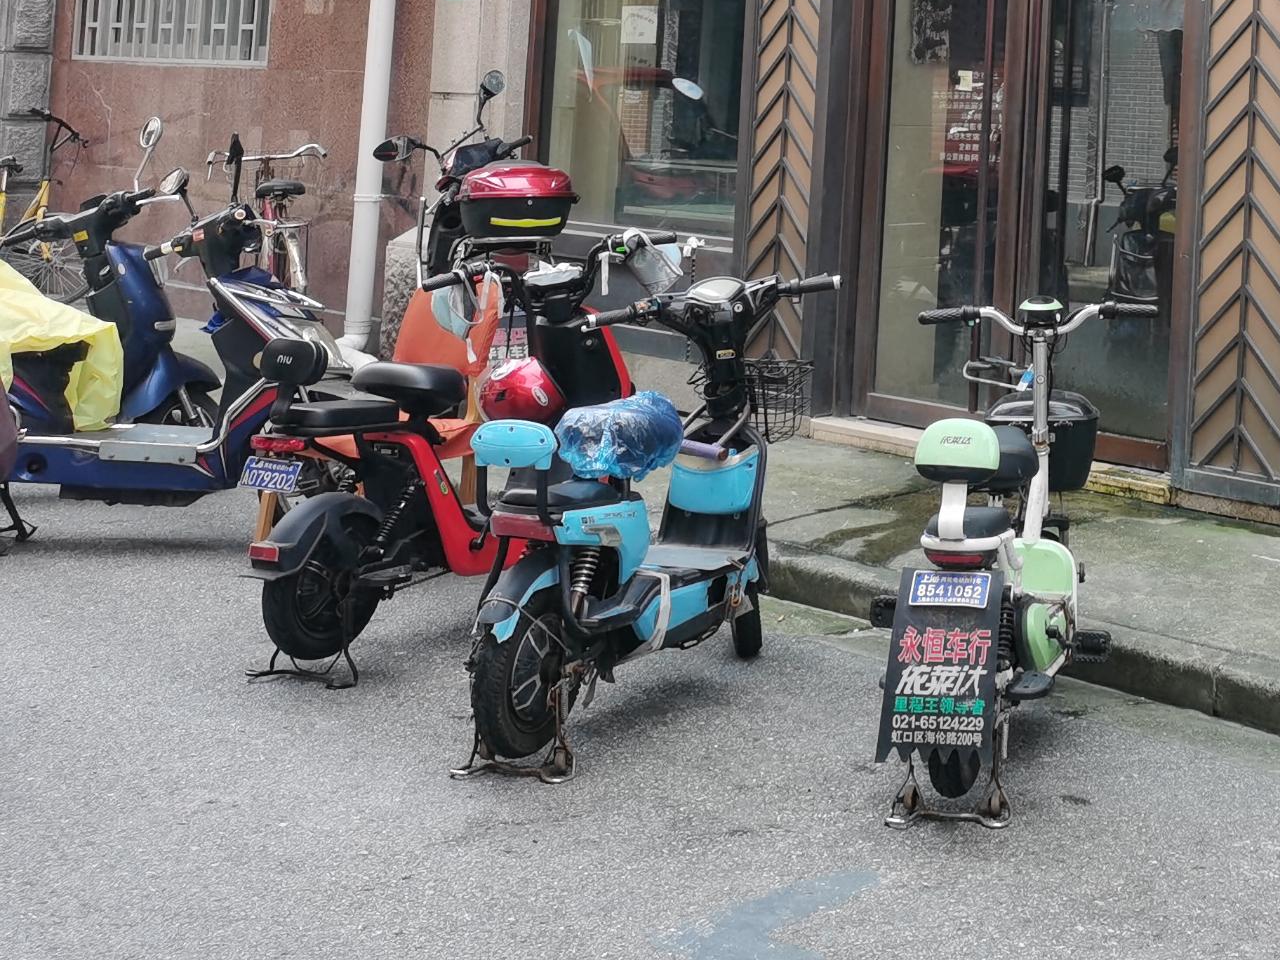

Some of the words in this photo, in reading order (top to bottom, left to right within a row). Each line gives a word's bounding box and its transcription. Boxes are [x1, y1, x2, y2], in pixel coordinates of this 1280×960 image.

[241, 469, 295, 490] A079202
[917, 584, 982, 599] 8541052
[897, 625, 992, 665] 永恒车行
[892, 715, 985, 730] 021-65124229
[891, 731, 983, 747] 虹口区海伦路200号
